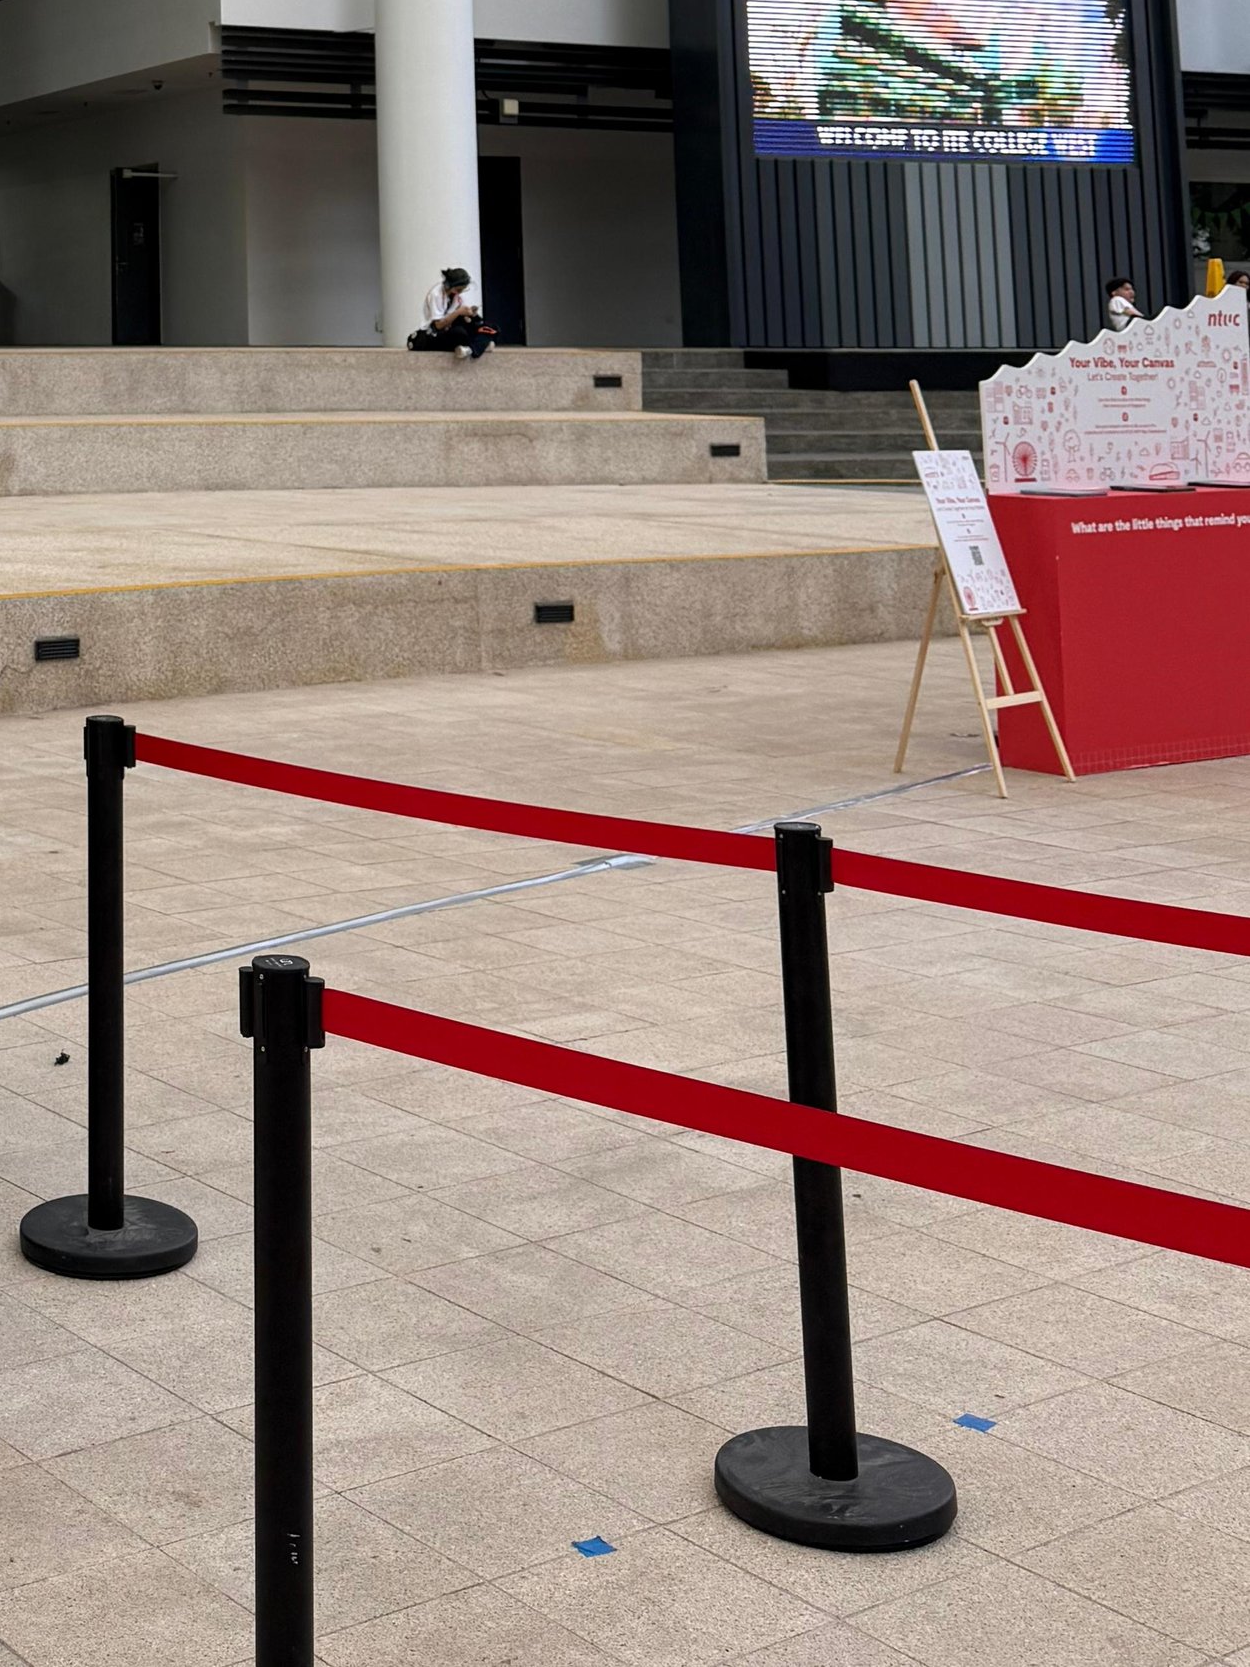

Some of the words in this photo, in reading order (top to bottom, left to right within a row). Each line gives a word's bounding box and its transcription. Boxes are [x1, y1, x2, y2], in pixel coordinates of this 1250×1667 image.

[1208, 309, 1240, 327] ntuc
[1069, 356, 1091, 368] Your
[1119, 356, 1140, 368] Your
[1142, 356, 1175, 368] Canvas
[1071, 521, 1097, 534] What
[1098, 522, 1114, 533] are
[1115, 519, 1131, 531] the
[1132, 518, 1154, 530] little
[1155, 517, 1183, 531] things
[1184, 515, 1203, 527] that
[1204, 513, 1235, 526] remind
